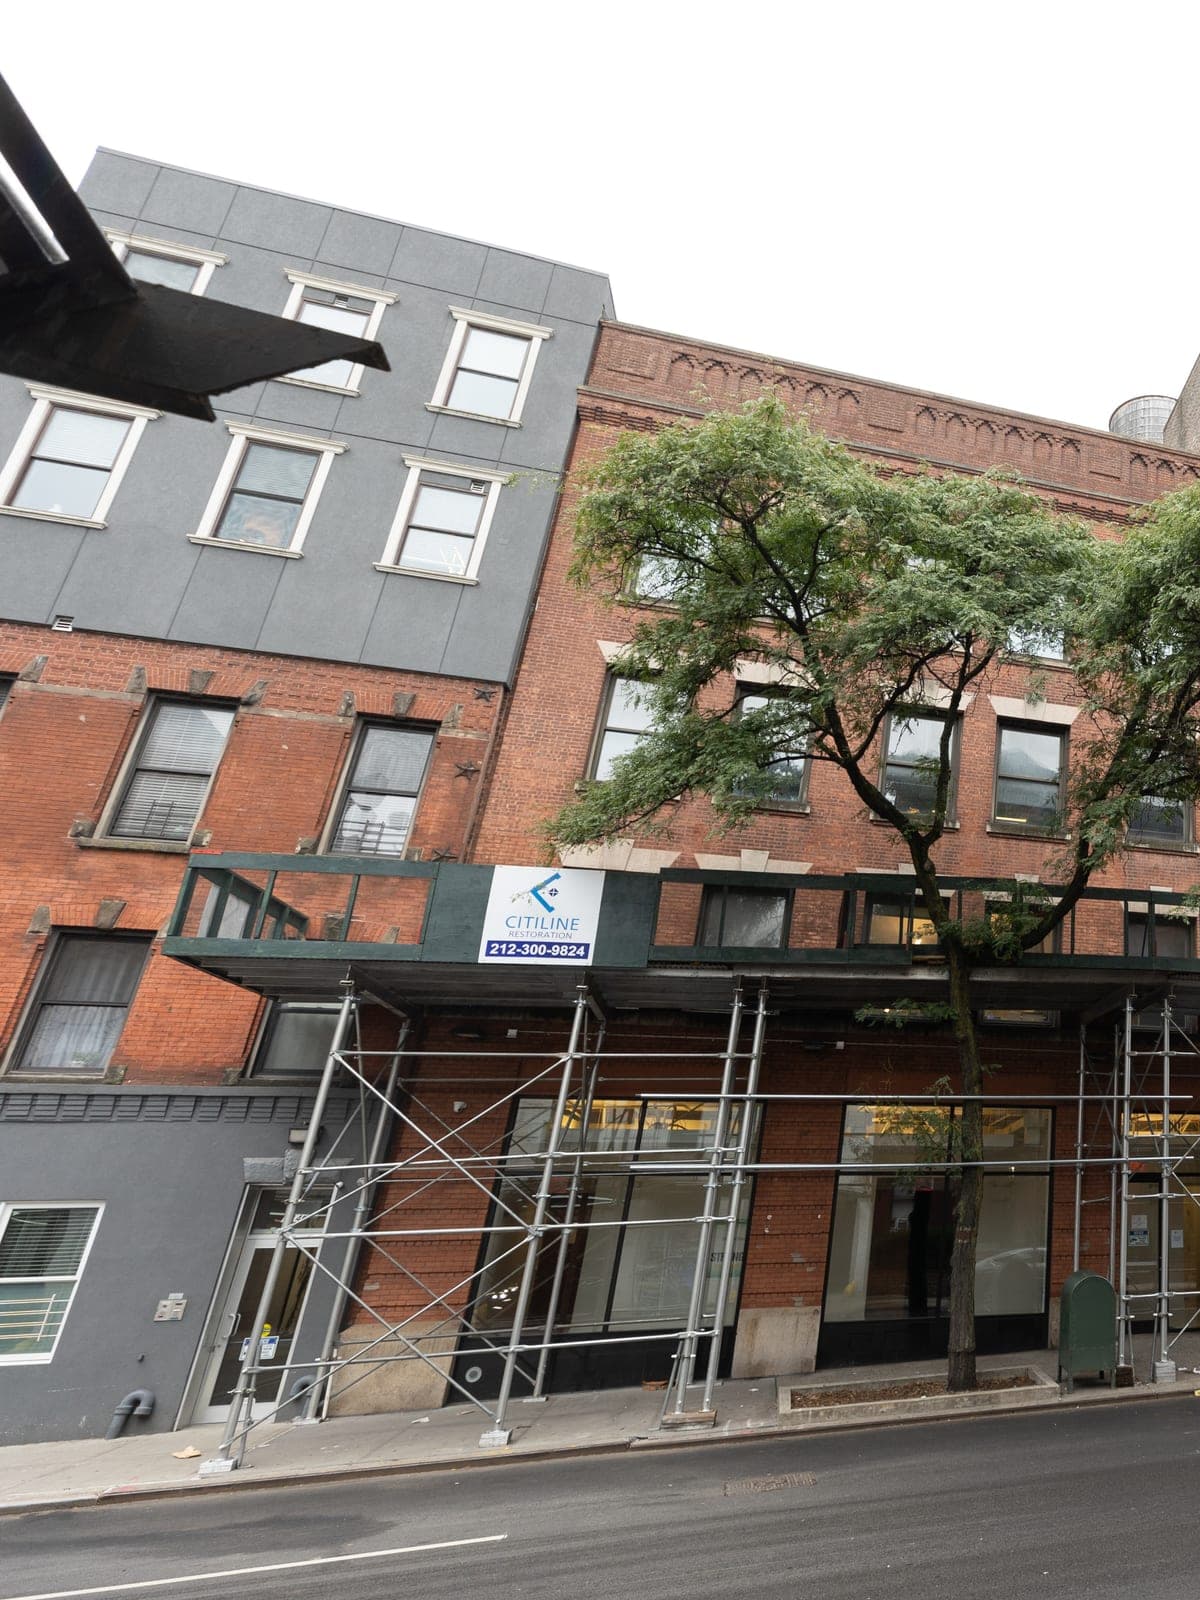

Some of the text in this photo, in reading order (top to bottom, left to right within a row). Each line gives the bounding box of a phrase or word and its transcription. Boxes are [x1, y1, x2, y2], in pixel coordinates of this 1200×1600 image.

[505, 915, 580, 931] CITILINE
[508, 930, 573, 940] RESTORATION
[489, 943, 585, 958] 212-300-9824
